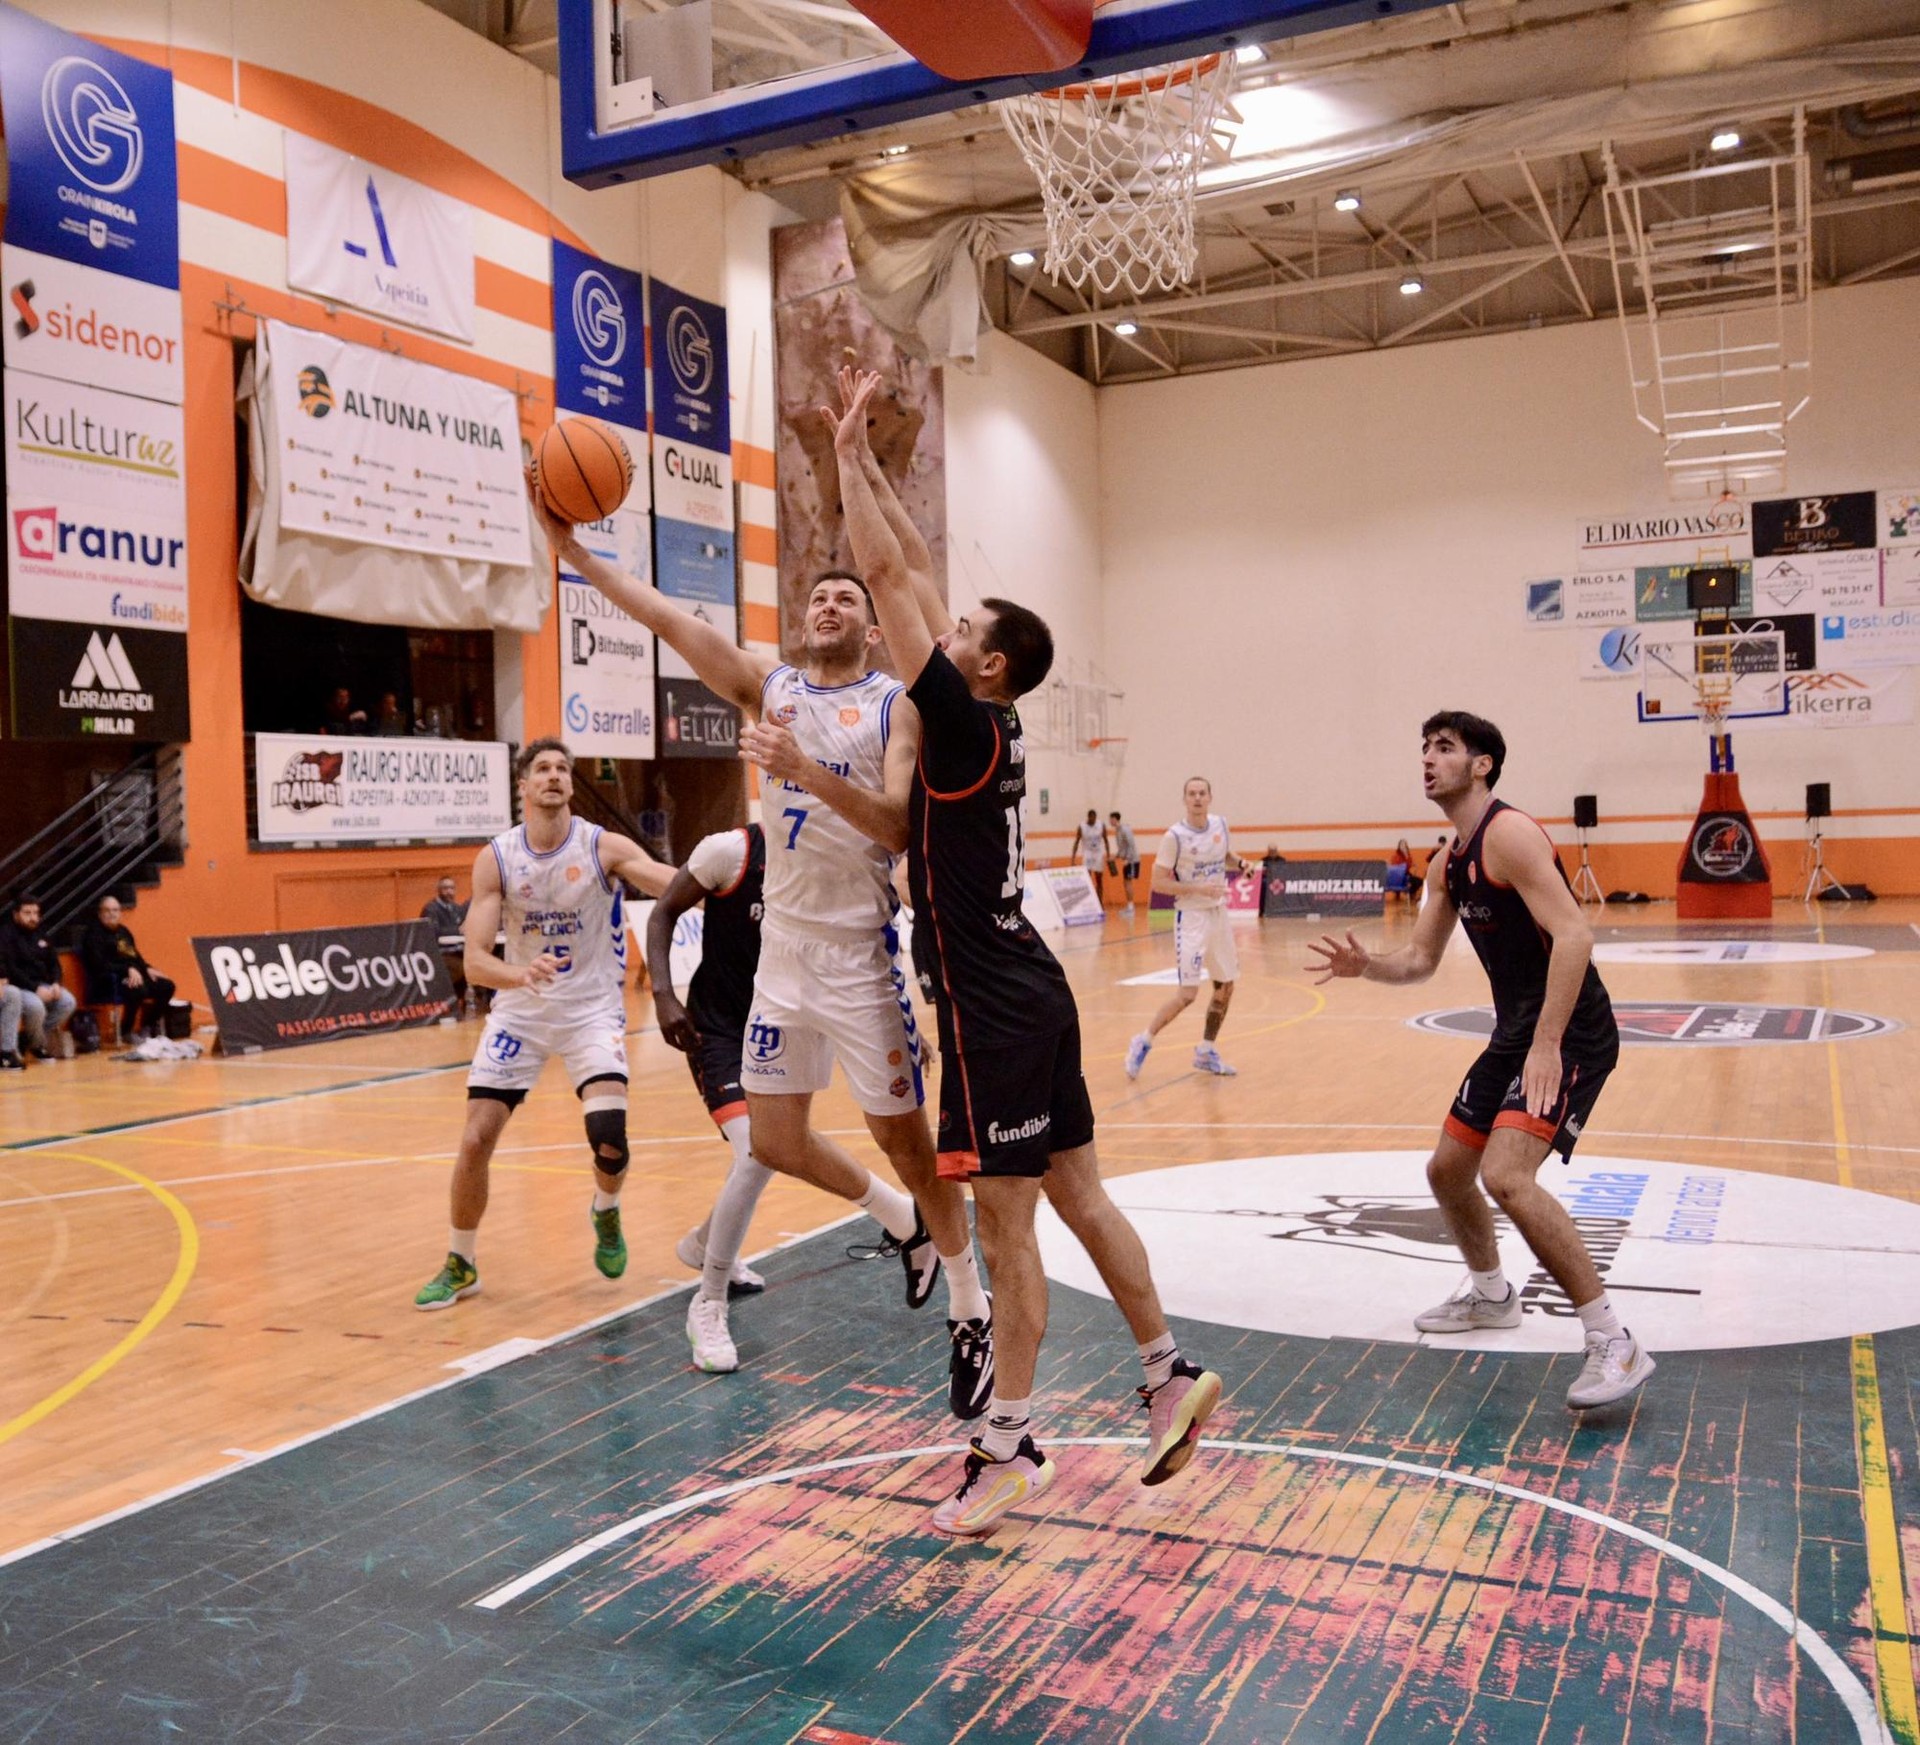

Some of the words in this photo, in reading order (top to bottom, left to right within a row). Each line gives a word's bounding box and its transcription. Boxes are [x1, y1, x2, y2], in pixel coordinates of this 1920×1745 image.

[45, 303, 177, 364] sidenor
[344, 389, 432, 434] ALTUNA
[437, 413, 448, 438] Y
[454, 419, 505, 451] URIA
[1612, 517, 1680, 543] DIARIO
[59, 688, 154, 711] LARRAMENDI
[592, 704, 650, 737] sarralle
[347, 751, 401, 783] IRAURGI
[405, 752, 441, 783] SASKI
[444, 753, 488, 783] BALOIA
[271, 780, 344, 808] IRAURGI
[782, 807, 808, 851] 7
[276, 1016, 337, 1037] PASSION
[338, 1012, 367, 1027] FOR
